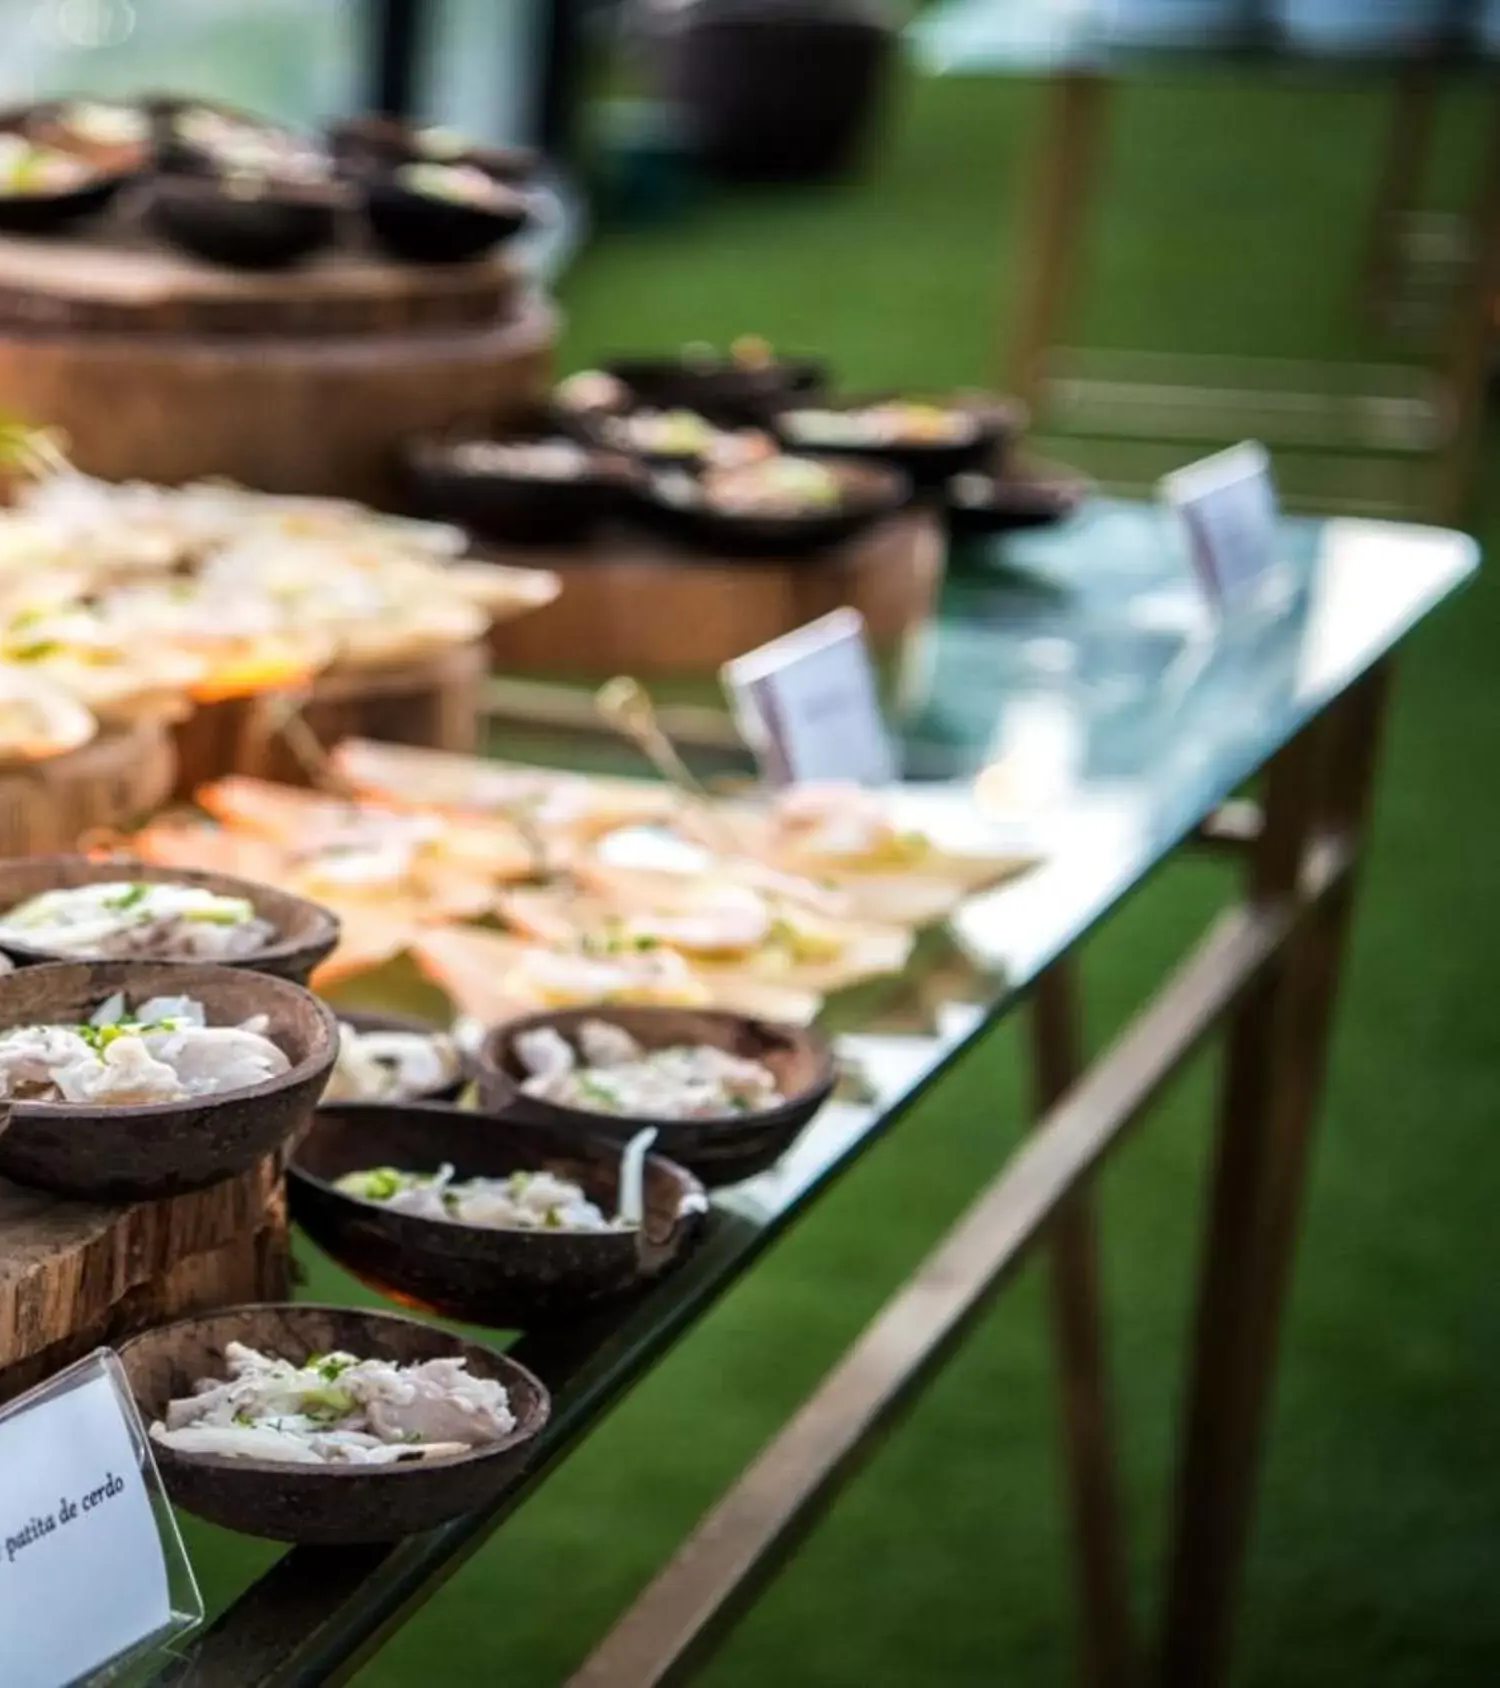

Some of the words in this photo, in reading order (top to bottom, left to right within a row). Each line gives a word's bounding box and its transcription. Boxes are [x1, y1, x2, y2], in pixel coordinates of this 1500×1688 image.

[5, 1515, 56, 1563] patita
[58, 1497, 78, 1525] de
[82, 1472, 124, 1512] cerdo
